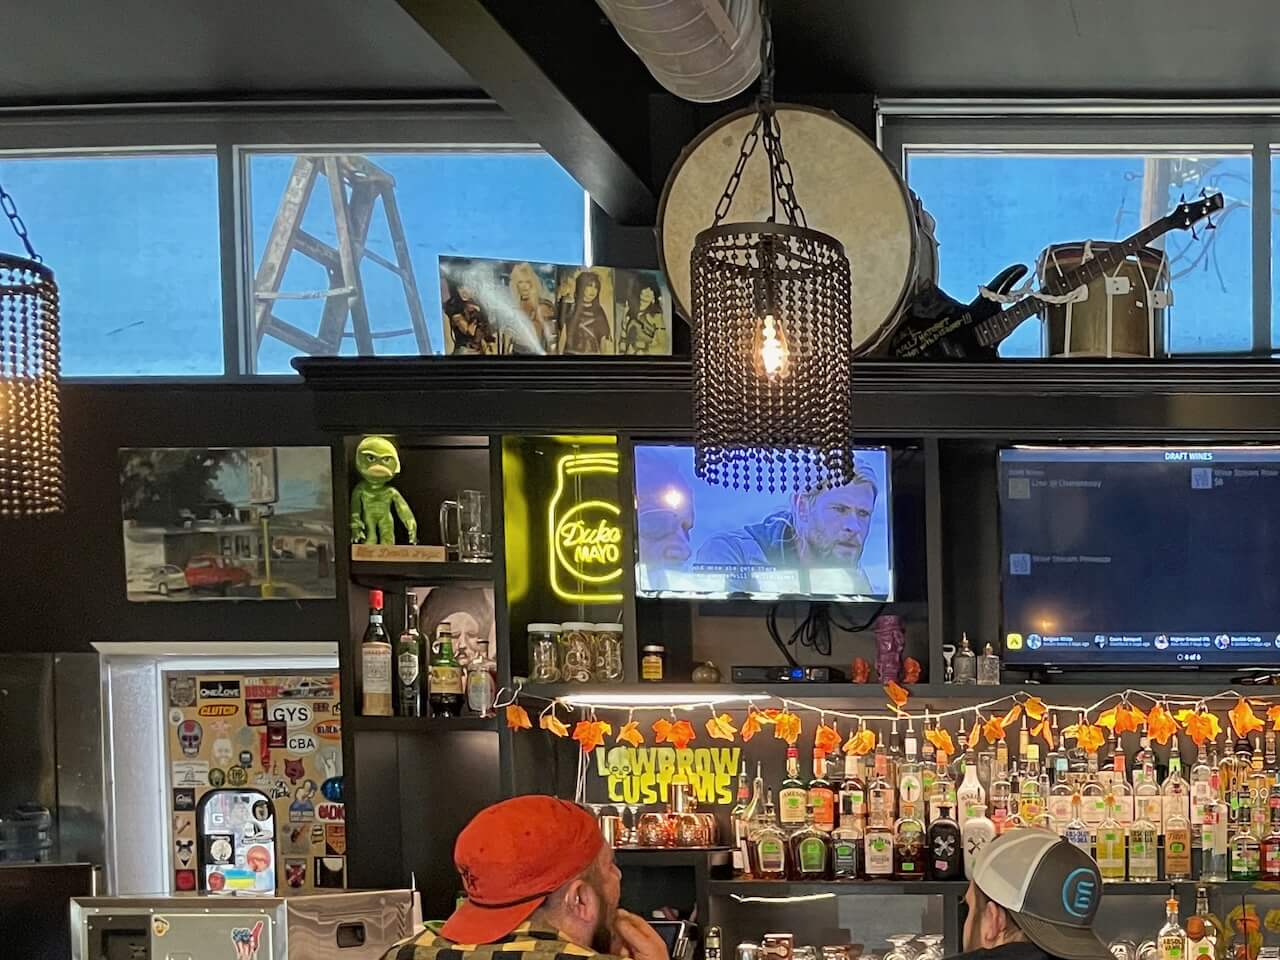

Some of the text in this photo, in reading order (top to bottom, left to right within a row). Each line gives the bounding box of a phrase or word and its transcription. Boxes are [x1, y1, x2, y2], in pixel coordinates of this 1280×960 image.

[1165, 452, 1213, 461] DRAFT WINES
[574, 544, 620, 563] MAYO
[200, 705, 237, 715] CLUTCH
[273, 708, 308, 722] GYS
[289, 738, 315, 750] CBA
[607, 772, 733, 805] CUSTMS
